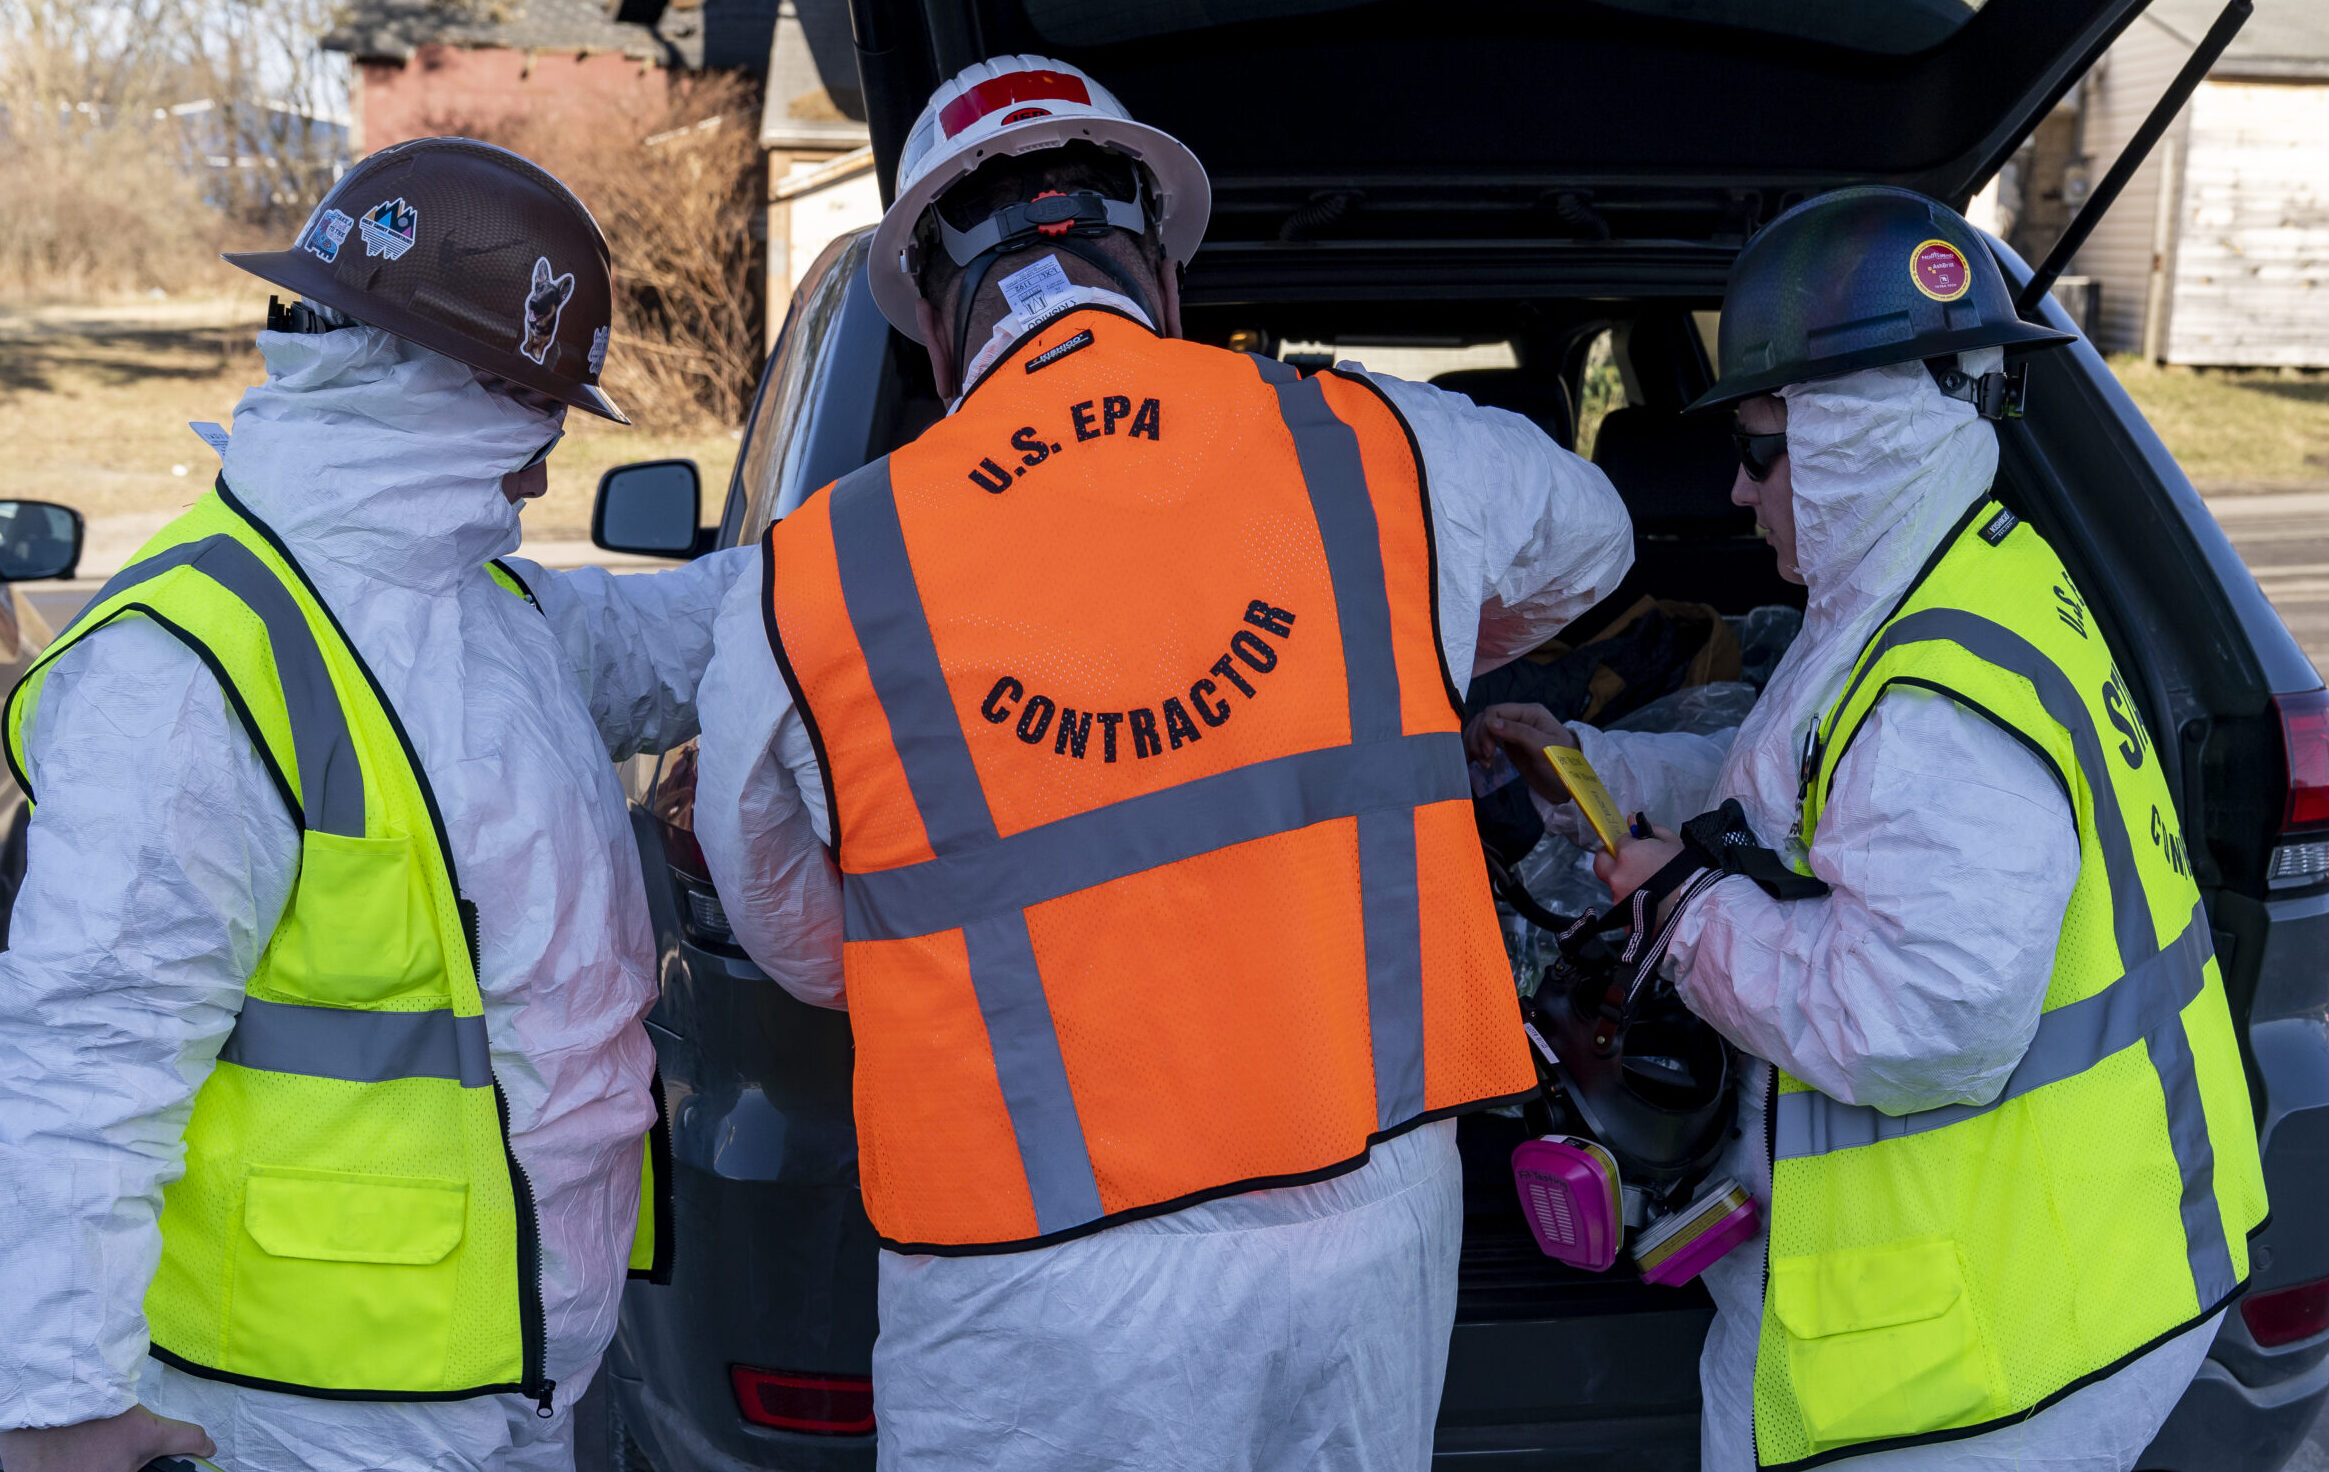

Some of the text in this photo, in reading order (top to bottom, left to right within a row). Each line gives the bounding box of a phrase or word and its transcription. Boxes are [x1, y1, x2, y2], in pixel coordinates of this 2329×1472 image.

[968, 395, 1161, 494] U.S. EPA
[981, 599, 1297, 763] CONTRACTOR
